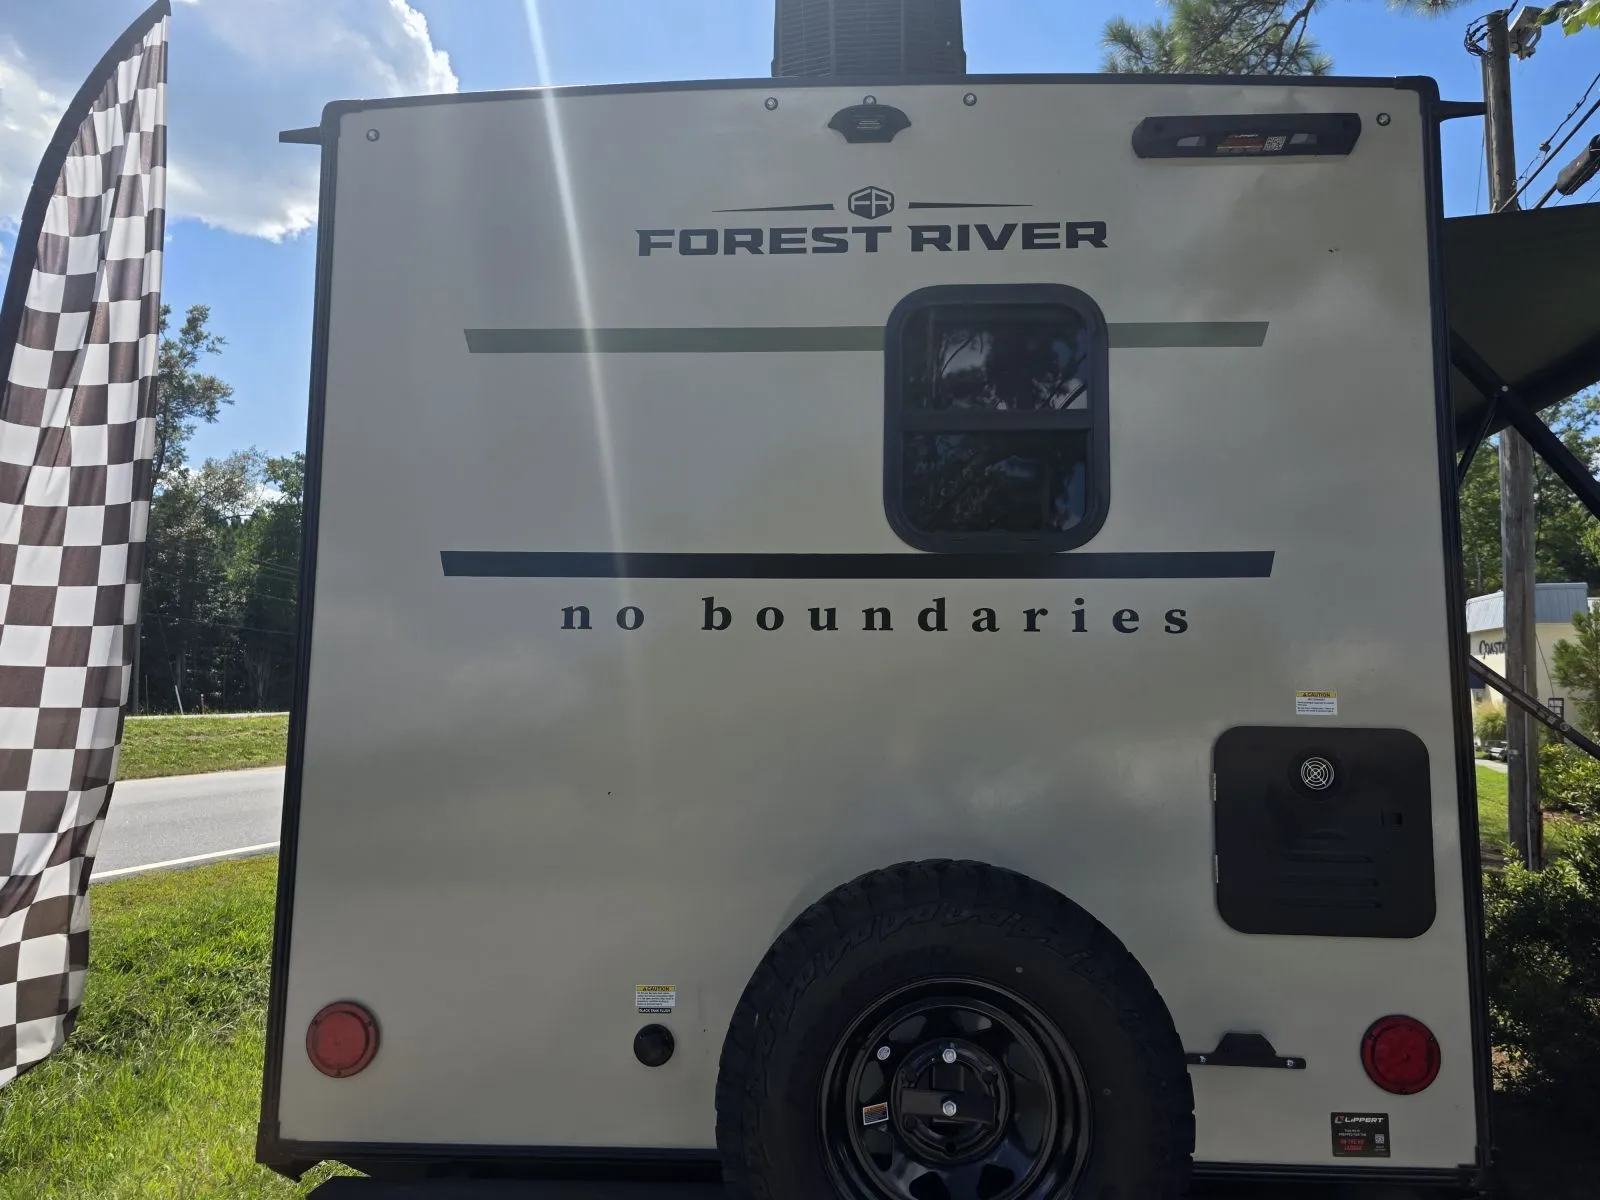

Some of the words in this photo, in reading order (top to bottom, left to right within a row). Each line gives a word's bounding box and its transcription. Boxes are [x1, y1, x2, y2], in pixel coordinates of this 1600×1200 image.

[635, 225, 892, 256] FOREST
[907, 220, 1109, 251] RIVER
[560, 605, 645, 631] no
[701, 596, 1189, 634] boundaries
